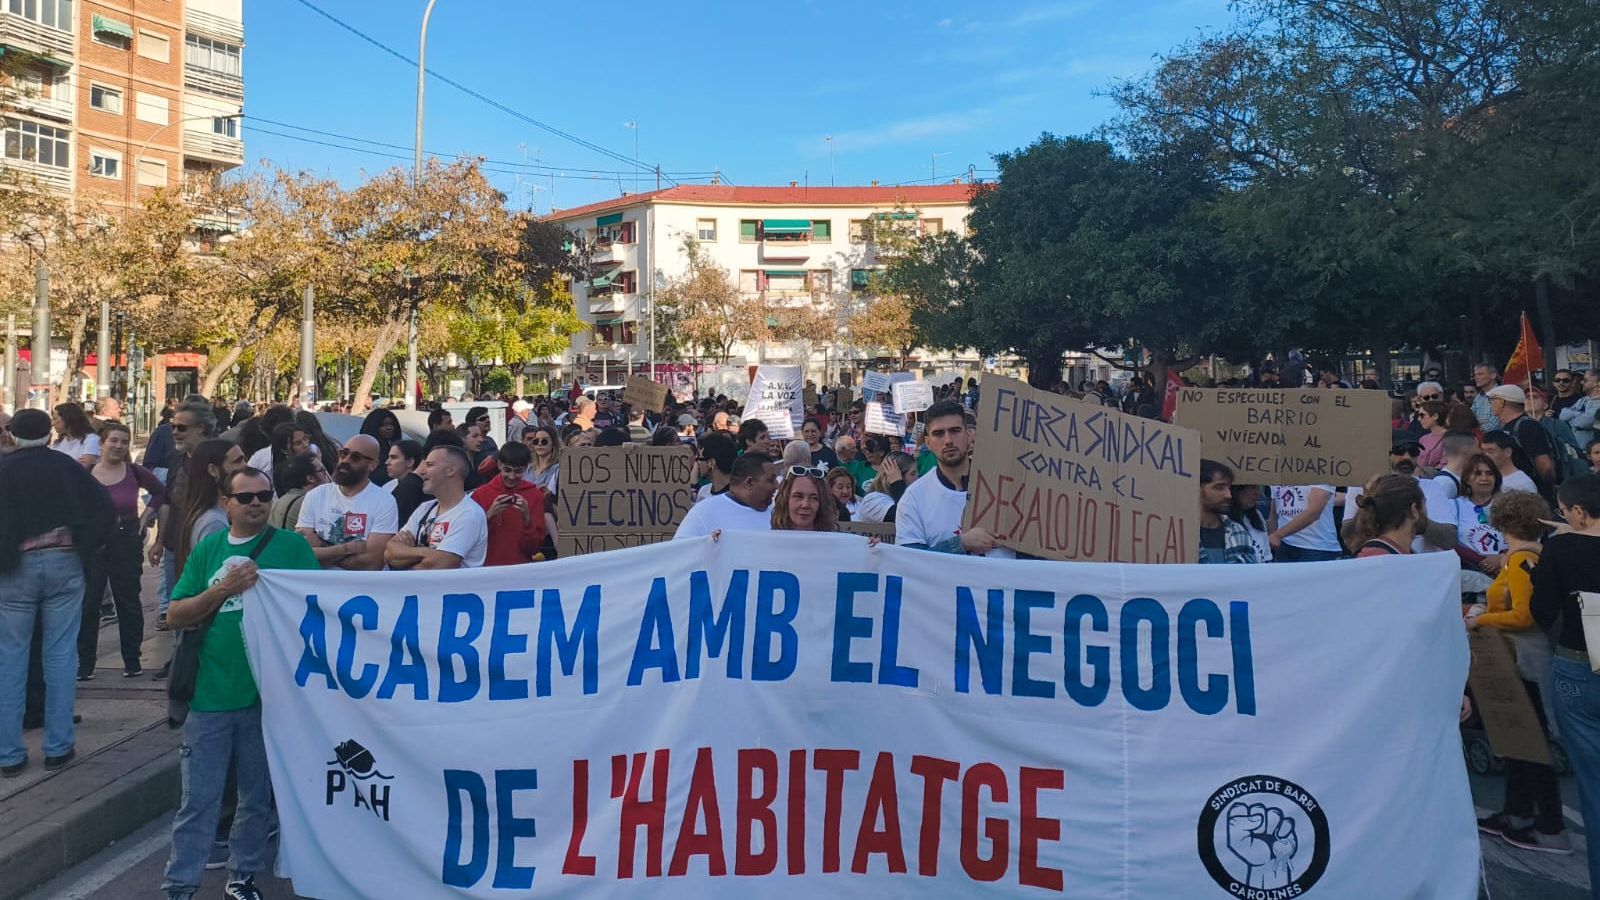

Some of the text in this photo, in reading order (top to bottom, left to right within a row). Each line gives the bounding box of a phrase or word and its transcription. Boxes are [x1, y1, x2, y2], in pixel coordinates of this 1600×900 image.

[762, 391, 796, 400] LA VOZ
[1182, 389, 1203, 402] NO
[1216, 391, 1286, 405] ESPECULES
[1301, 394, 1320, 405] CON
[1335, 395, 1352, 407] EL
[993, 388, 1080, 454] FUERZA
[1247, 407, 1317, 426] BARRIO
[1304, 435, 1322, 448] AL
[567, 452, 691, 485] LOS NUEVOS
[1016, 450, 1144, 501] CONTRA EL
[560, 488, 689, 528] VECINOS
[294, 569, 1256, 716] ACABEM AMB EL NEGOCI
[326, 769, 391, 821] PAH
[1211, 779, 1317, 812] SINDICAT DE BARRI
[441, 746, 1065, 892] DE L'HABITATGE
[1230, 882, 1302, 900] CAROLINES
